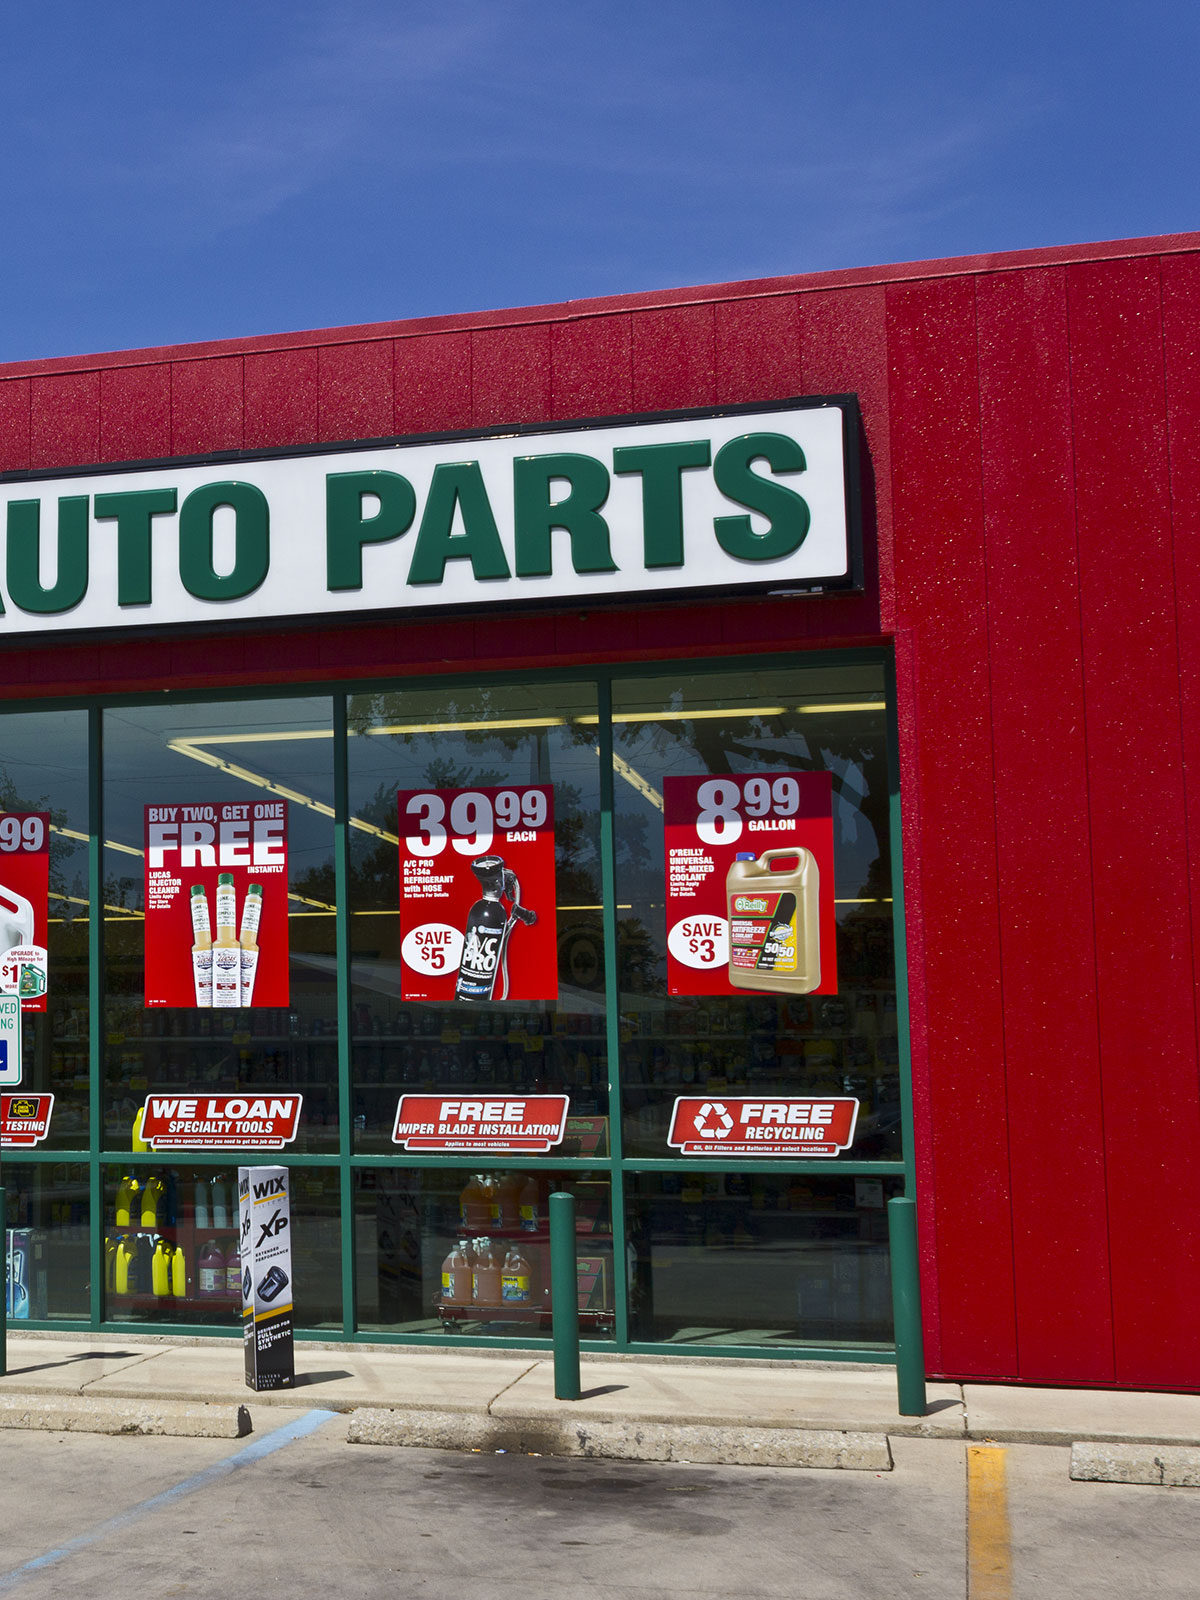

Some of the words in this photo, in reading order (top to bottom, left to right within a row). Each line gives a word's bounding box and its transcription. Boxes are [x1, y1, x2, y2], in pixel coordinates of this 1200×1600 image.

[326, 431, 811, 591] PARTS
[149, 807, 177, 822] BUY
[181, 806, 218, 823] TWO,
[222, 805, 250, 820] GET
[254, 804, 284, 819] ONE
[748, 819, 796, 831] GALLON
[506, 831, 536, 842] EACH
[149, 820, 285, 868] FREE
[403, 860, 417, 868] A/C
[418, 859, 434, 868] PRO
[670, 857, 714, 865] UNIVERSAL
[149, 871, 171, 879] LUCAS
[247, 865, 284, 873] INSTANTLY
[403, 868, 430, 876] R-134a
[670, 865, 714, 873] PRE-MIXED
[404, 875, 454, 884] REFRIGERANT
[404, 885, 421, 893] with
[422, 884, 442, 892] HOSE
[682, 923, 722, 937] SAVE
[415, 931, 452, 945] SAVE
[421, 946, 445, 969] $5
[689, 939, 715, 963] $3
[462, 951, 496, 971] PRO
[2, 965, 18, 982] $1
[152, 1100, 198, 1119] WE
[206, 1100, 293, 1119] LOAN
[439, 1102, 526, 1122] FREE
[739, 1104, 835, 1124] FREE
[6, 1121, 45, 1131] TESTING
[168, 1121, 233, 1133] SPECIALTY
[235, 1121, 274, 1133] TOOLS
[398, 1123, 434, 1135] WIPER
[438, 1124, 476, 1135] BLADE
[479, 1124, 559, 1136] INSTALLATION
[745, 1127, 825, 1140] RECYCLING
[252, 1175, 286, 1199] WIX
[255, 1208, 289, 1249] XP
[255, 1246, 280, 1257] EXTENDED
[255, 1249, 289, 1263] PERFORMANCE
[257, 1323, 280, 1335] DESIGNED
[257, 1331, 273, 1341] FULL
[257, 1329, 291, 1346] SYNTHETIC
[257, 1342, 272, 1351] OILS
